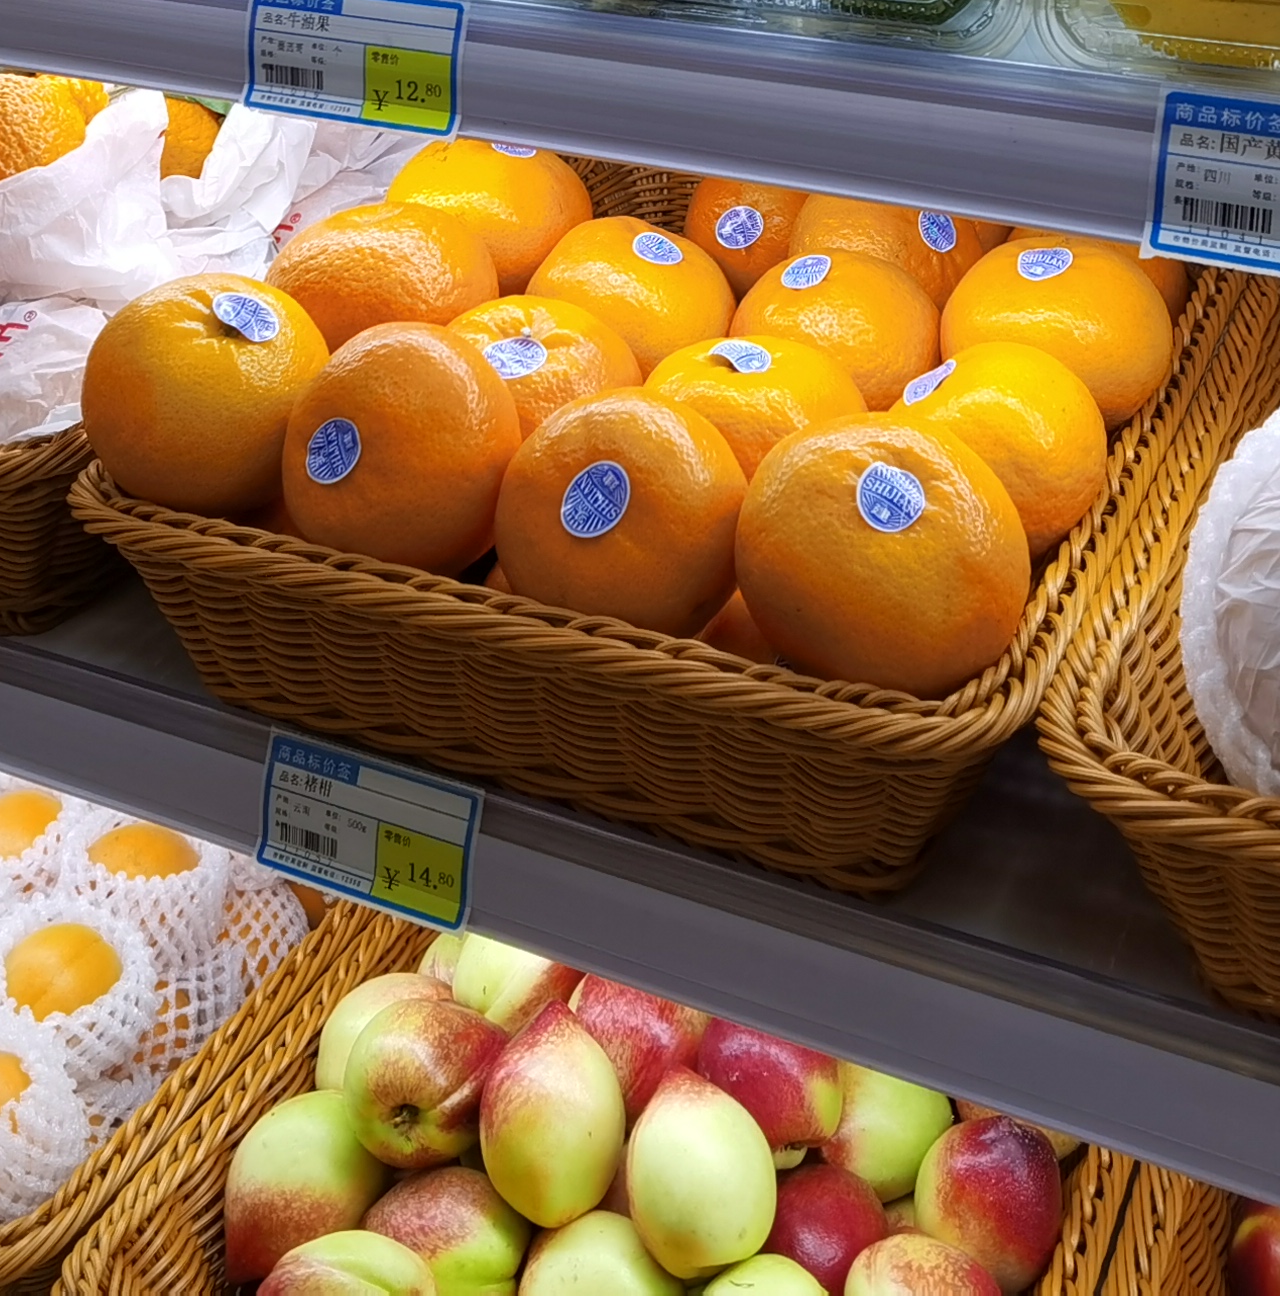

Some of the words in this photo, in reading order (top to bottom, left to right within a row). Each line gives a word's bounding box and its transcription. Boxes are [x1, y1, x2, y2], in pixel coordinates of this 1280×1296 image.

[395, 79, 442, 103] 12.80
[1204, 169, 1232, 185] 四川
[575, 473, 621, 521] SHIJIAN
[862, 477, 918, 517] SHIJIAN
[278, 744, 352, 781] 商品标价签
[384, 830, 411, 848] 零售价
[408, 862, 455, 891] 14.80
